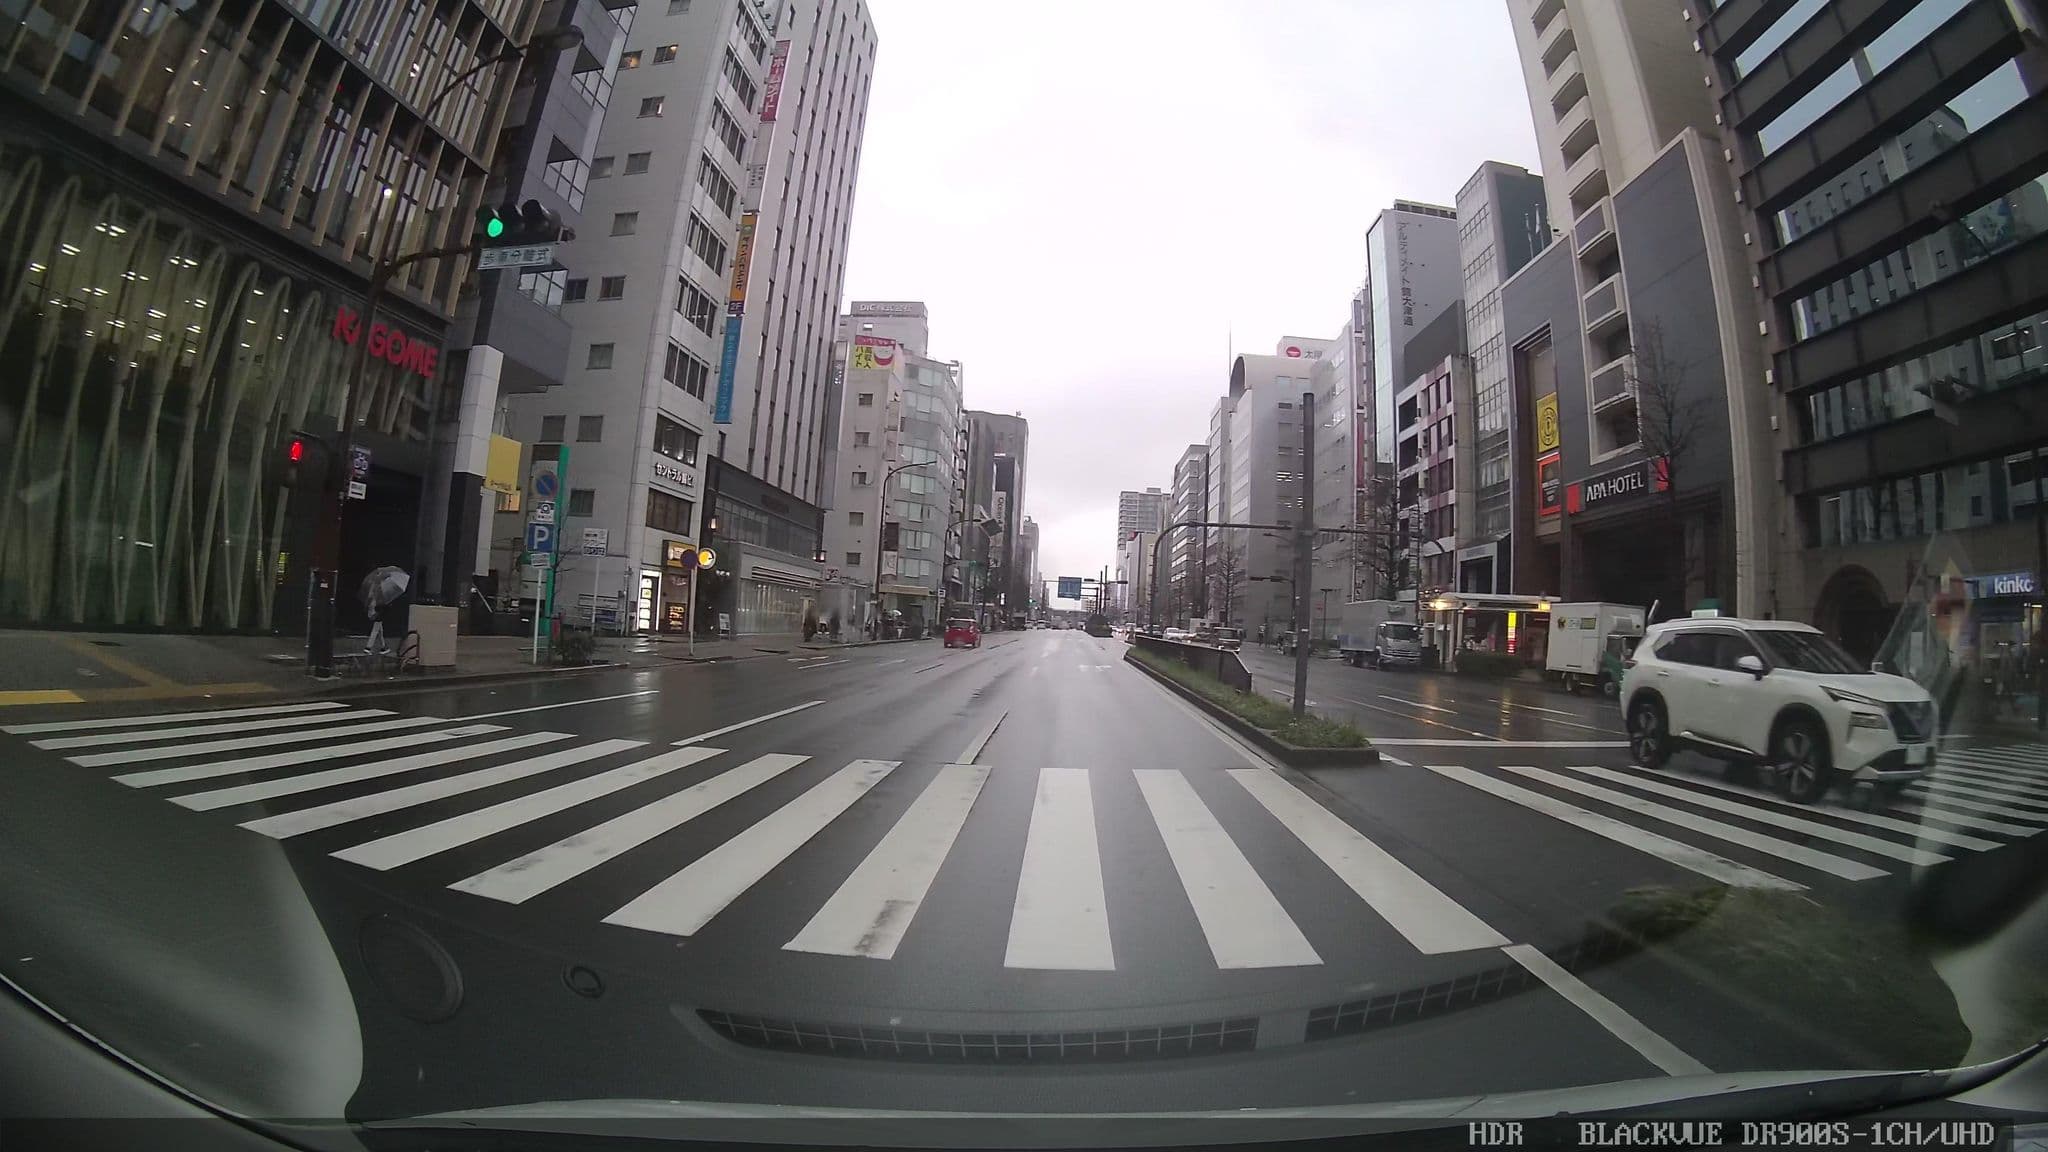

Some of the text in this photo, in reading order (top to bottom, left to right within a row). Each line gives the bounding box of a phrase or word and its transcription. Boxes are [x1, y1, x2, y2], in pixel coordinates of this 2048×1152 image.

[1586, 482, 1607, 502] APA
[1608, 471, 1645, 496] HOTEL
[533, 525, 550, 550] P
